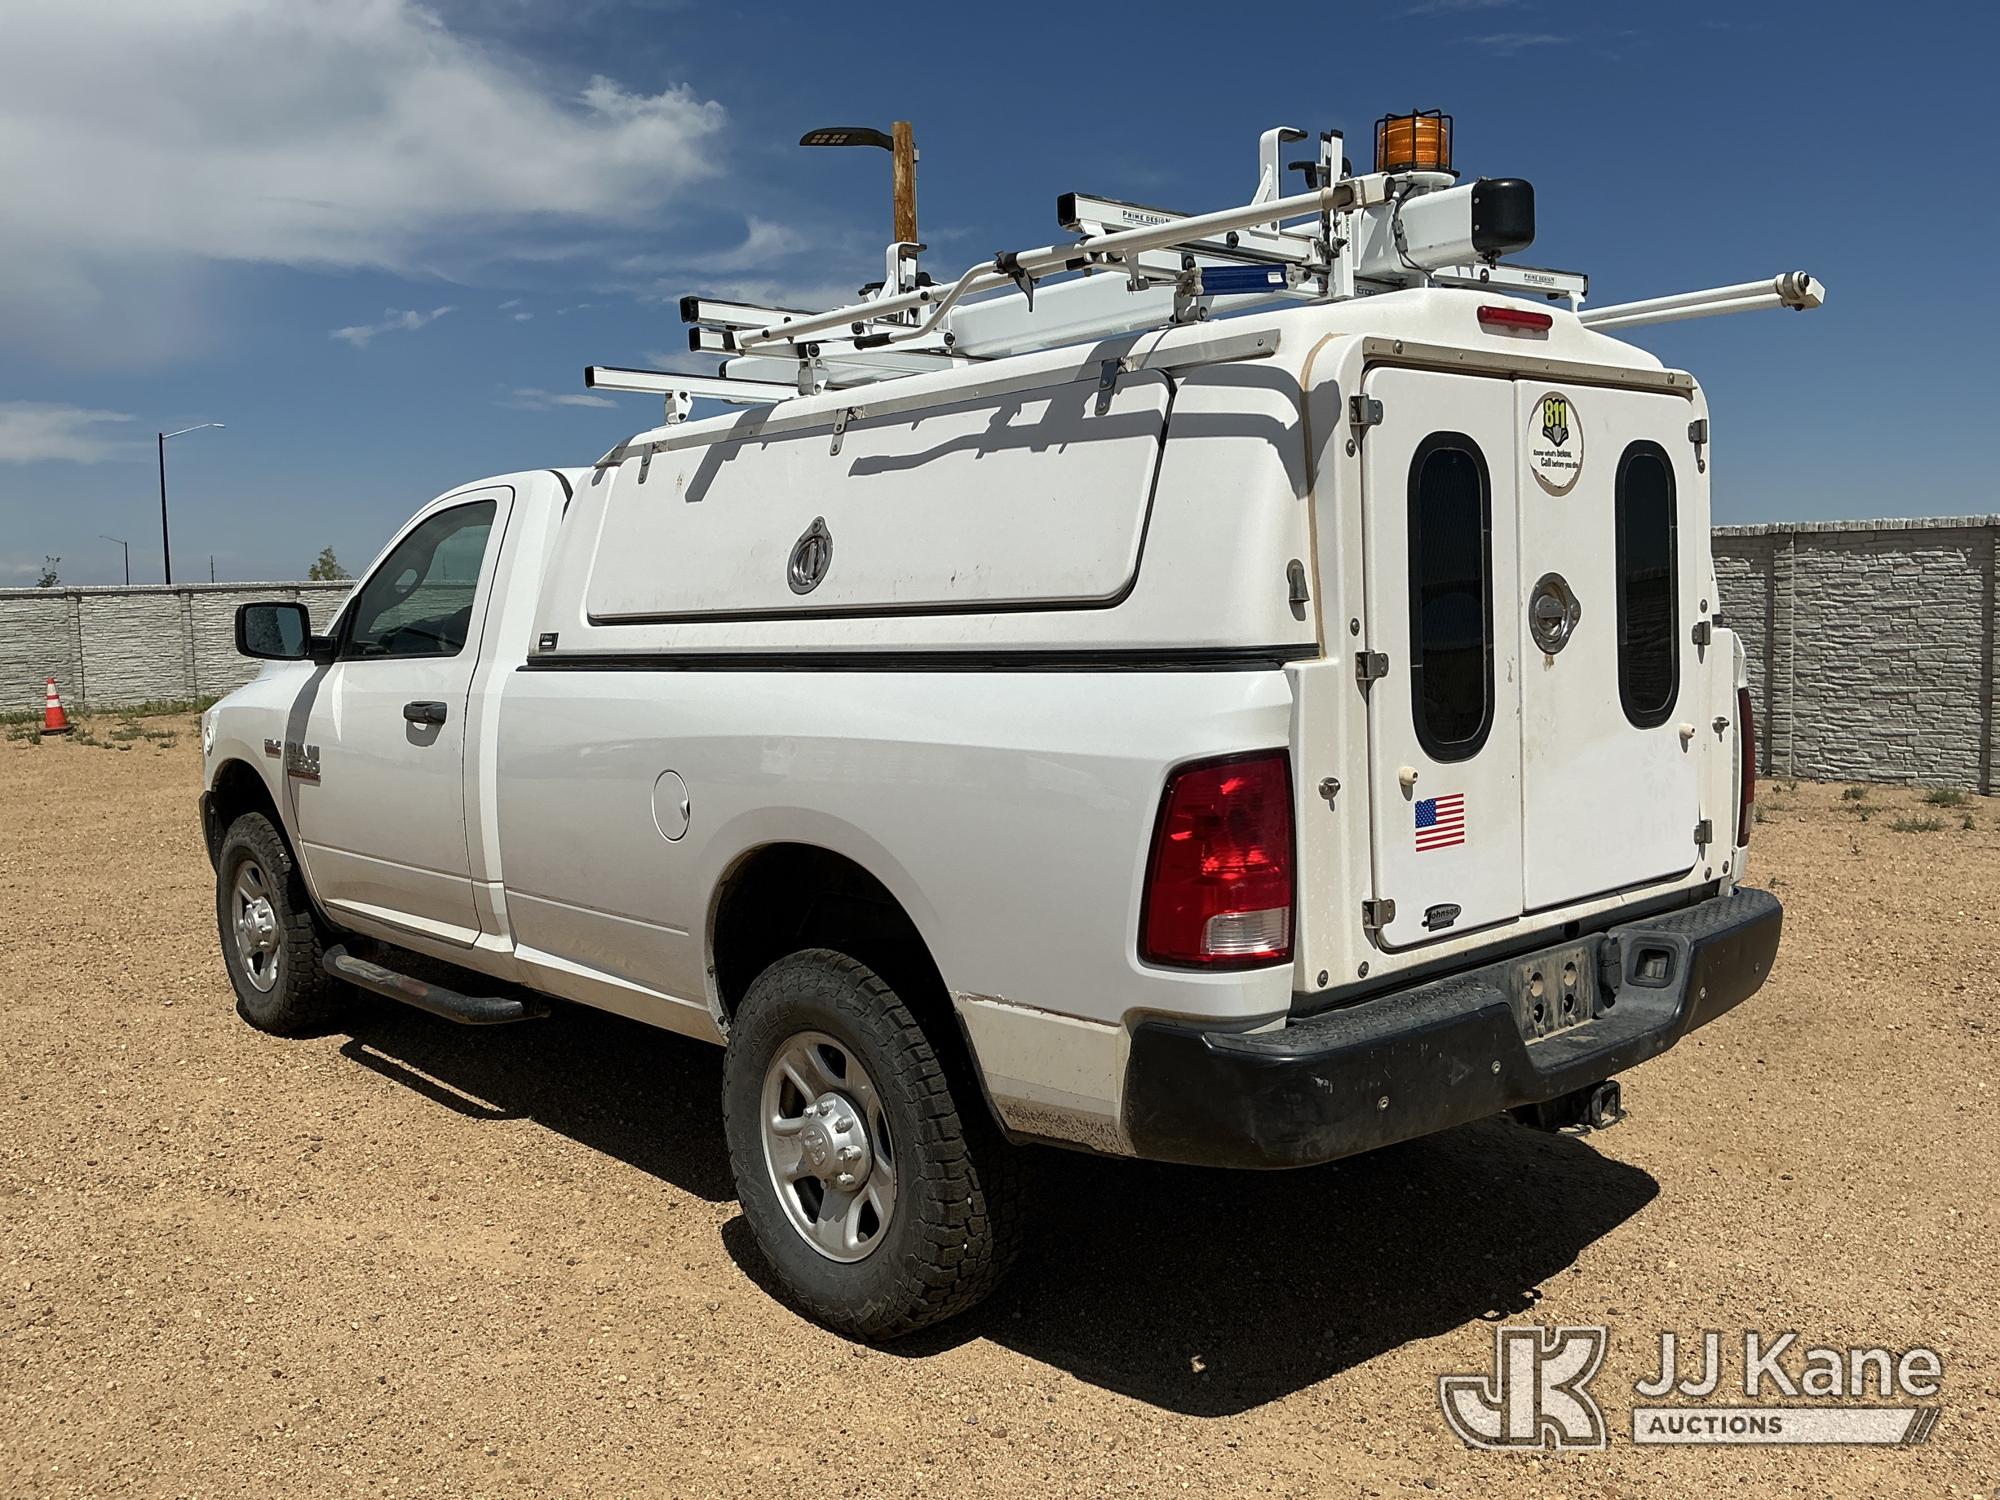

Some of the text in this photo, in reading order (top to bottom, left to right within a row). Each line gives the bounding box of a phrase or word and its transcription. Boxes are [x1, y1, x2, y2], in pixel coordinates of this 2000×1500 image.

[1123, 210, 1144, 220] PRIME
[1146, 215, 1171, 224] DESIGN
[1543, 398, 1567, 429] 811
[1541, 457, 1551, 467] Call
